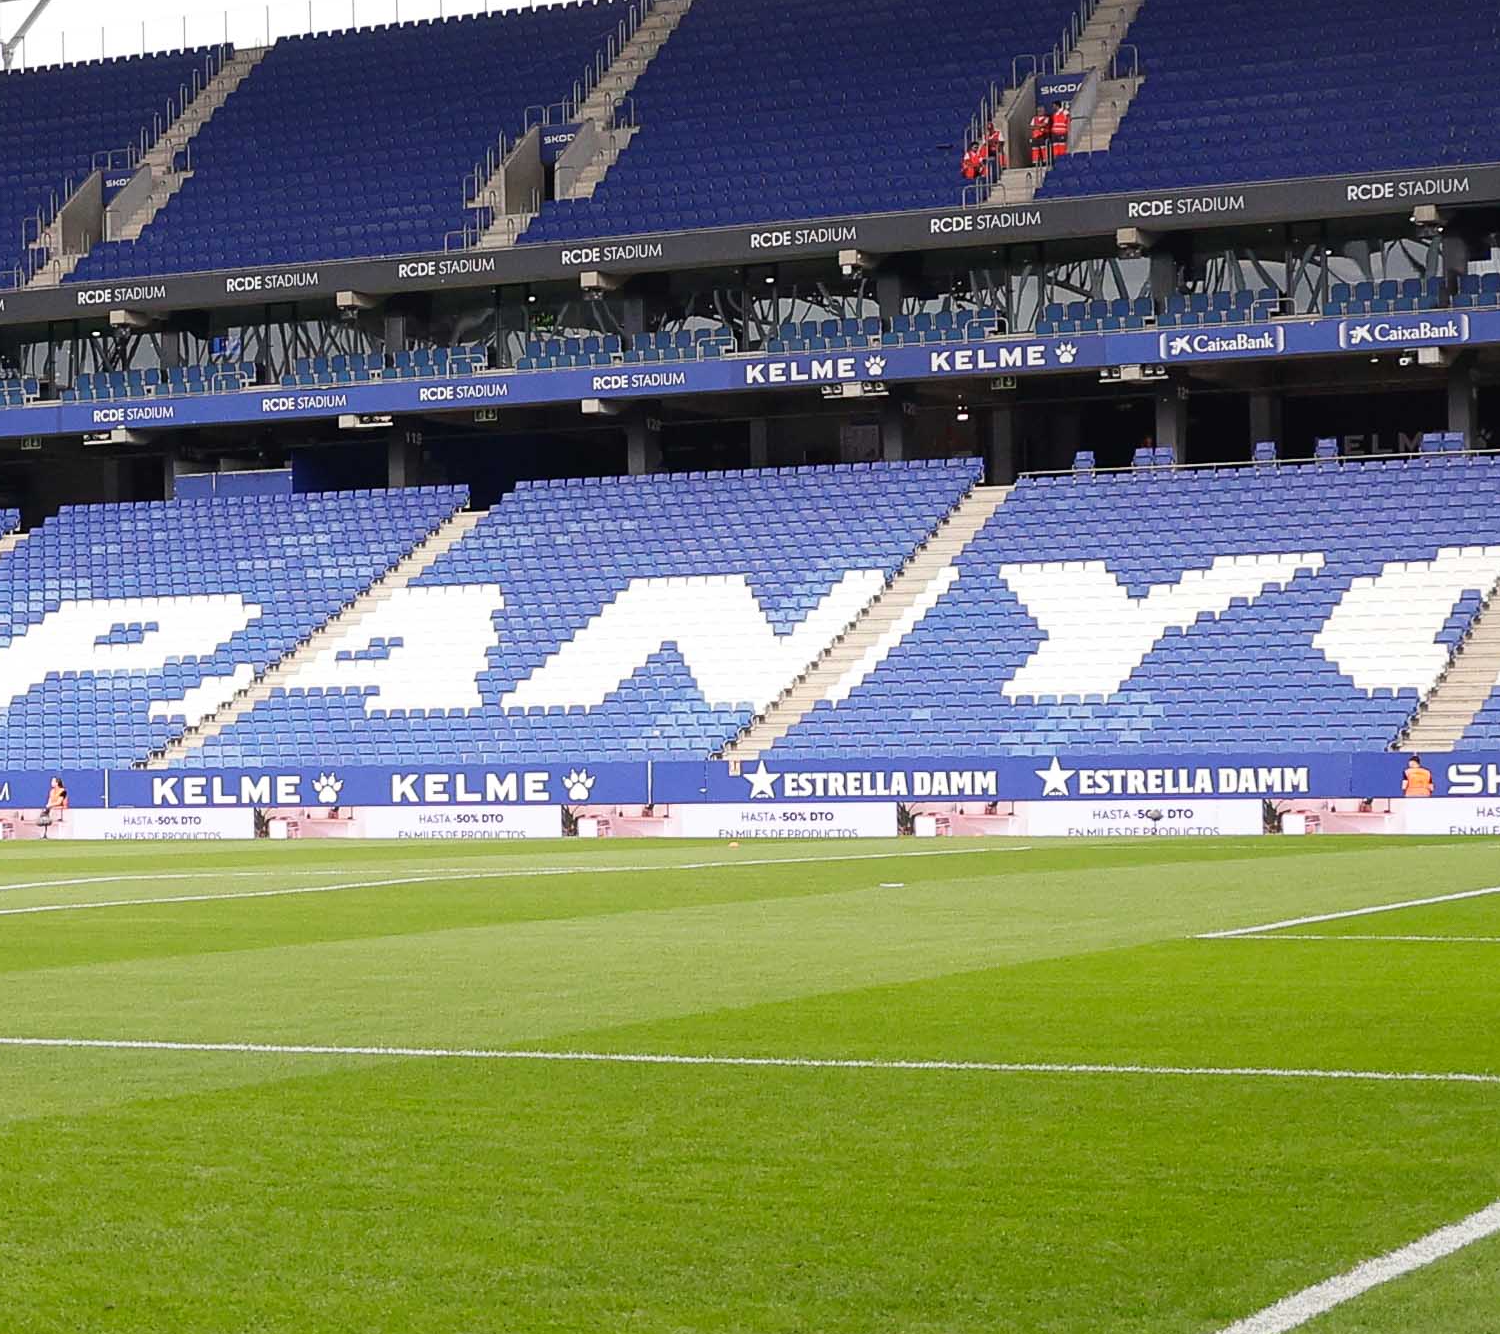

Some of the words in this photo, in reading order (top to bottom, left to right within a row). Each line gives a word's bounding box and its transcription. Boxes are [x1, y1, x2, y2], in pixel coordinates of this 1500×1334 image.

[543, 133, 576, 144] SKOD
[1347, 182, 1394, 201] RCDE
[1398, 177, 1469, 197] STADIUM
[1128, 199, 1173, 218] RCDE
[1177, 195, 1245, 214] STADIUM
[930, 215, 973, 234] RCDE
[976, 211, 1041, 230] STADIUM
[750, 230, 792, 248] RCDE
[795, 226, 857, 245] STADIUM
[561, 247, 601, 265] RCDE
[603, 243, 662, 261] STADIUM
[398, 261, 436, 278] RCDE
[438, 257, 495, 275] STADIUM
[226, 275, 262, 292] RCDE
[264, 272, 319, 289] STADIUM
[77, 288, 112, 305] RCDE
[114, 285, 166, 302] STADIUM
[1374, 320, 1459, 341] CaixaBank
[1193, 332, 1274, 353] CaixaBank
[931, 345, 1046, 372] KELME
[593, 374, 629, 390] RCDE
[631, 372, 685, 388] STADIUM
[746, 357, 856, 384] KELME
[419, 386, 454, 401] RCDE
[456, 383, 508, 399] STADIUM
[262, 397, 295, 412] RCDE
[297, 394, 347, 410] STADIUM
[93, 408, 125, 423] RCDE
[126, 406, 174, 421] STADIUM
[153, 775, 301, 805] KELME
[392, 772, 549, 803] KELME
[784, 772, 908, 797] ESTRELLA
[913, 771, 997, 796] DAMM
[1079, 769, 1213, 794] ESTRELLA
[1218, 767, 1308, 793] DAMM
[419, 813, 450, 823] HASTA
[453, 813, 479, 823] -50%
[482, 813, 504, 823] DTO
[741, 811, 776, 822] HASTA
[778, 811, 806, 822] -50%
[810, 811, 834, 822] DTO
[1092, 809, 1131, 819] HASTA
[1167, 808, 1194, 819] DTO
[1449, 825, 1467, 835] EN
